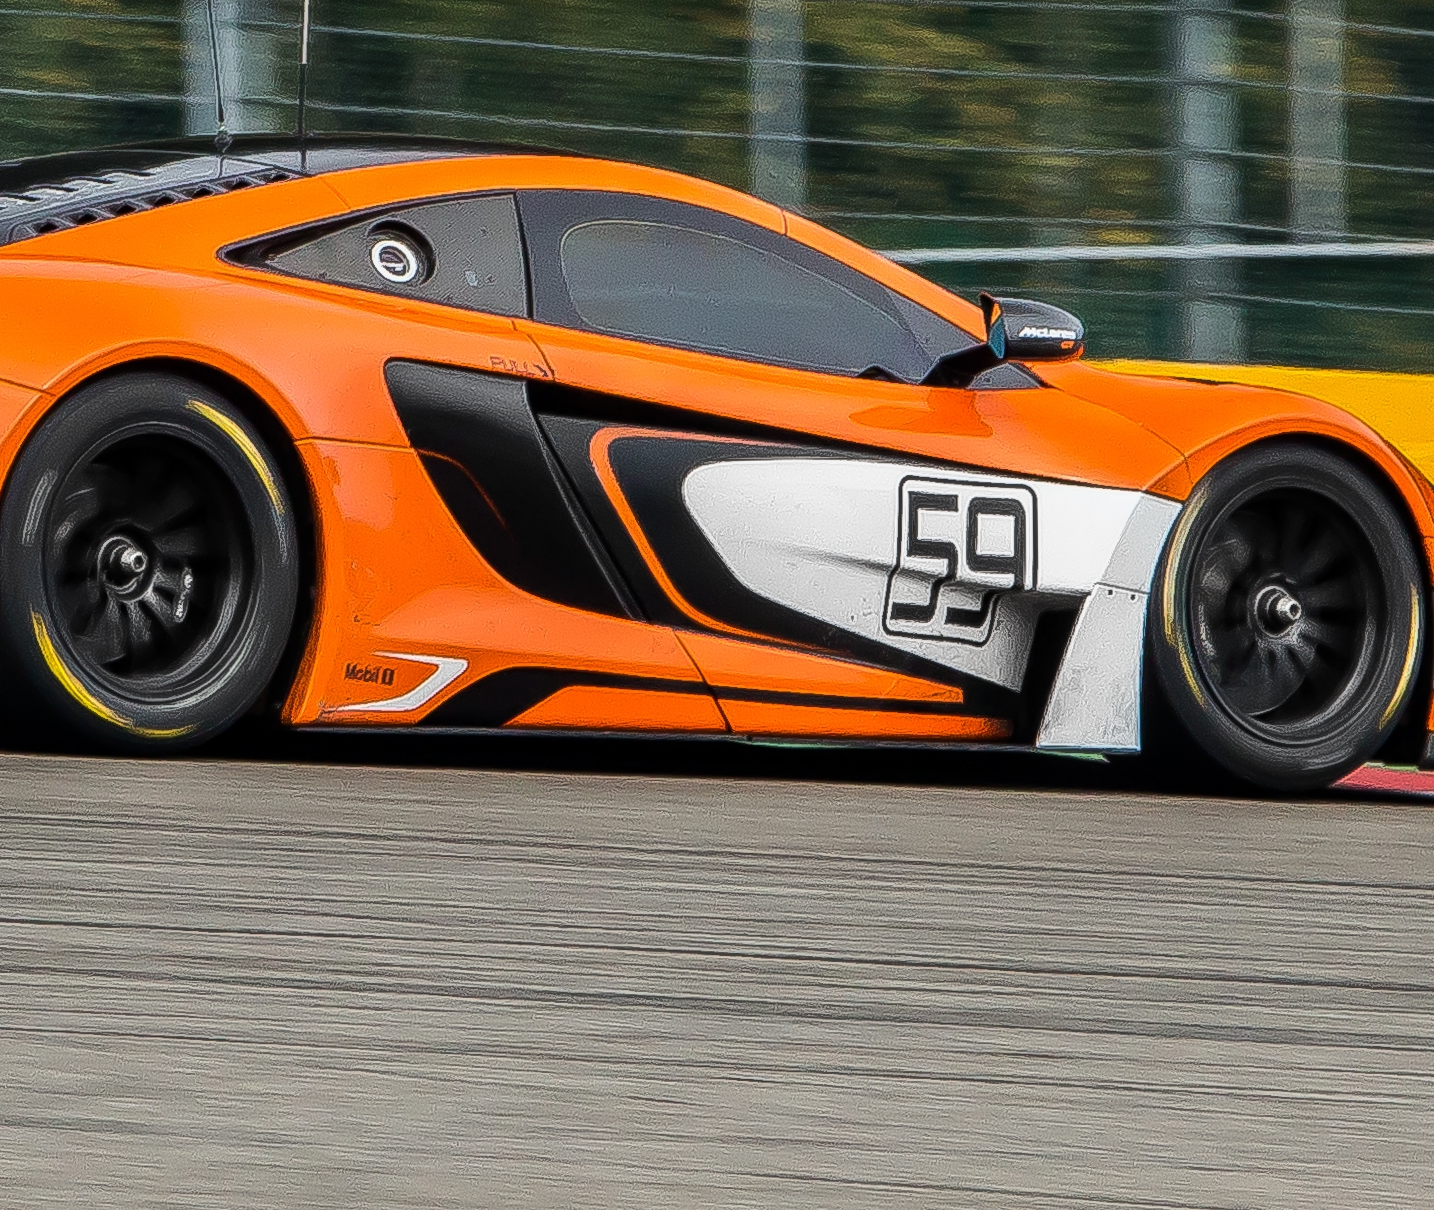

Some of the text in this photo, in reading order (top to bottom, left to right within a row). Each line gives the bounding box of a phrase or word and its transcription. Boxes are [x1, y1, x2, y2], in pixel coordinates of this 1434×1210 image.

[490, 355, 536, 377] PULL
[889, 490, 1027, 629] 59
[345, 662, 380, 684] Mobil
